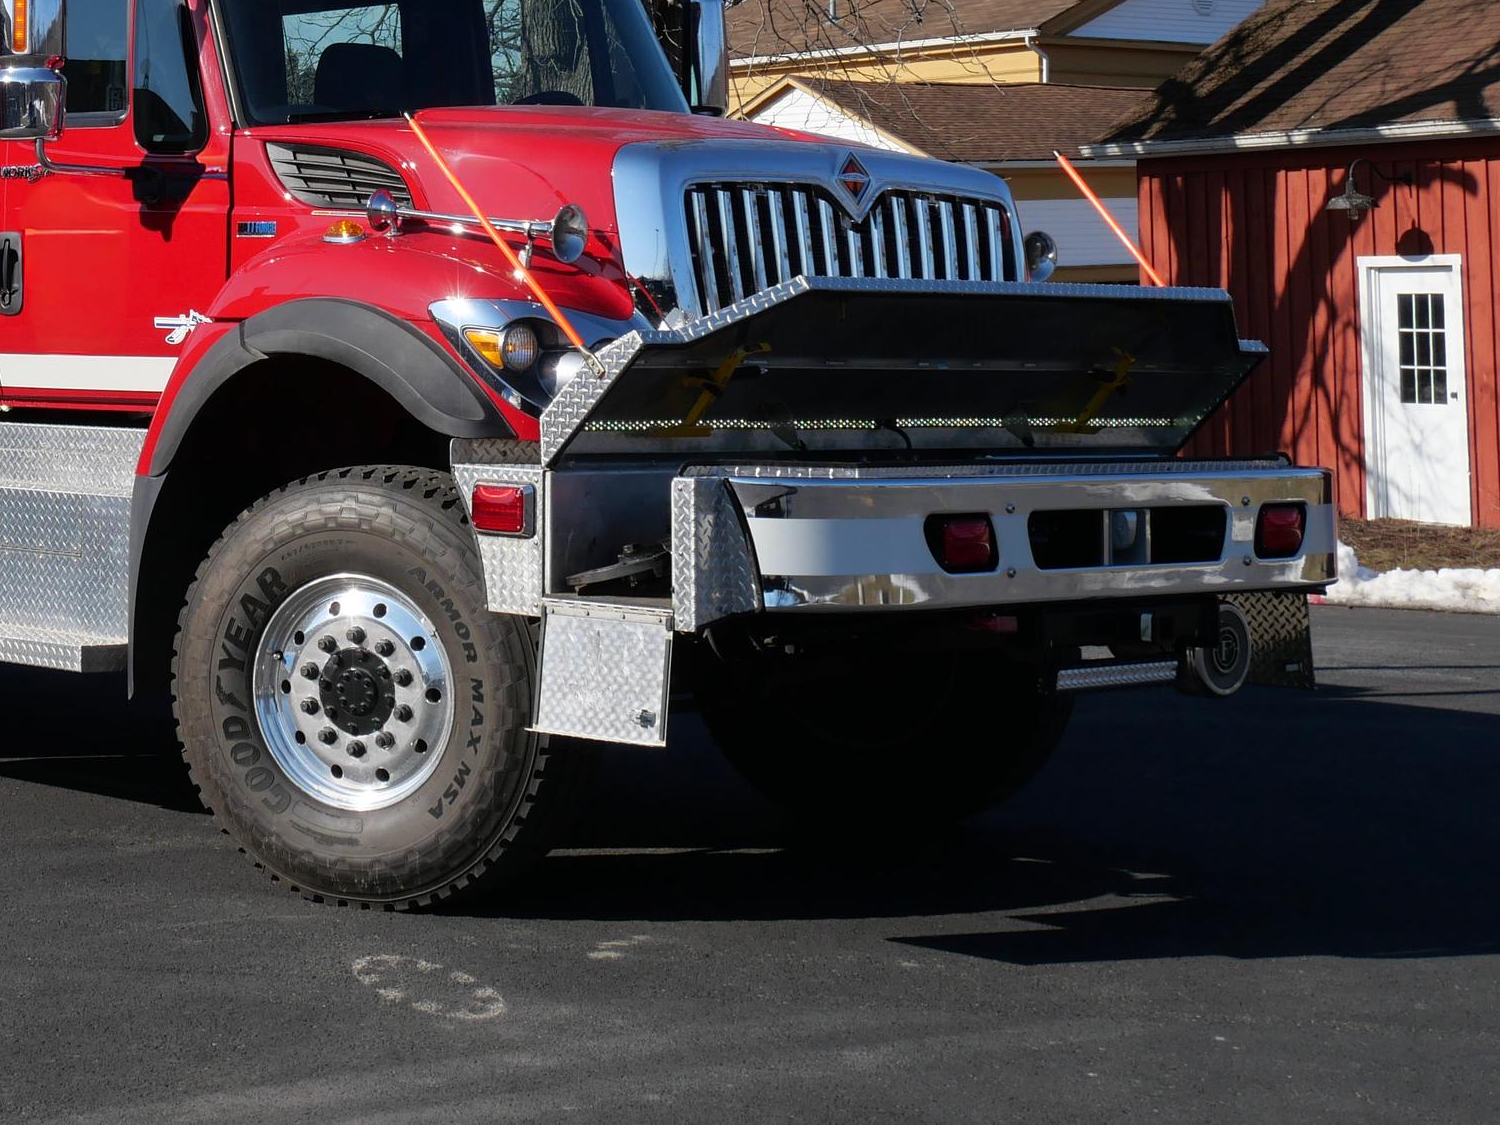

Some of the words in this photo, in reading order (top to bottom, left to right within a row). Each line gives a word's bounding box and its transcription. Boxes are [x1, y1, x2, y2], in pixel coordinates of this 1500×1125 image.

[407, 565, 478, 664] ARMOR
[466, 677, 485, 756] MAX
[427, 760, 472, 820] MSA
